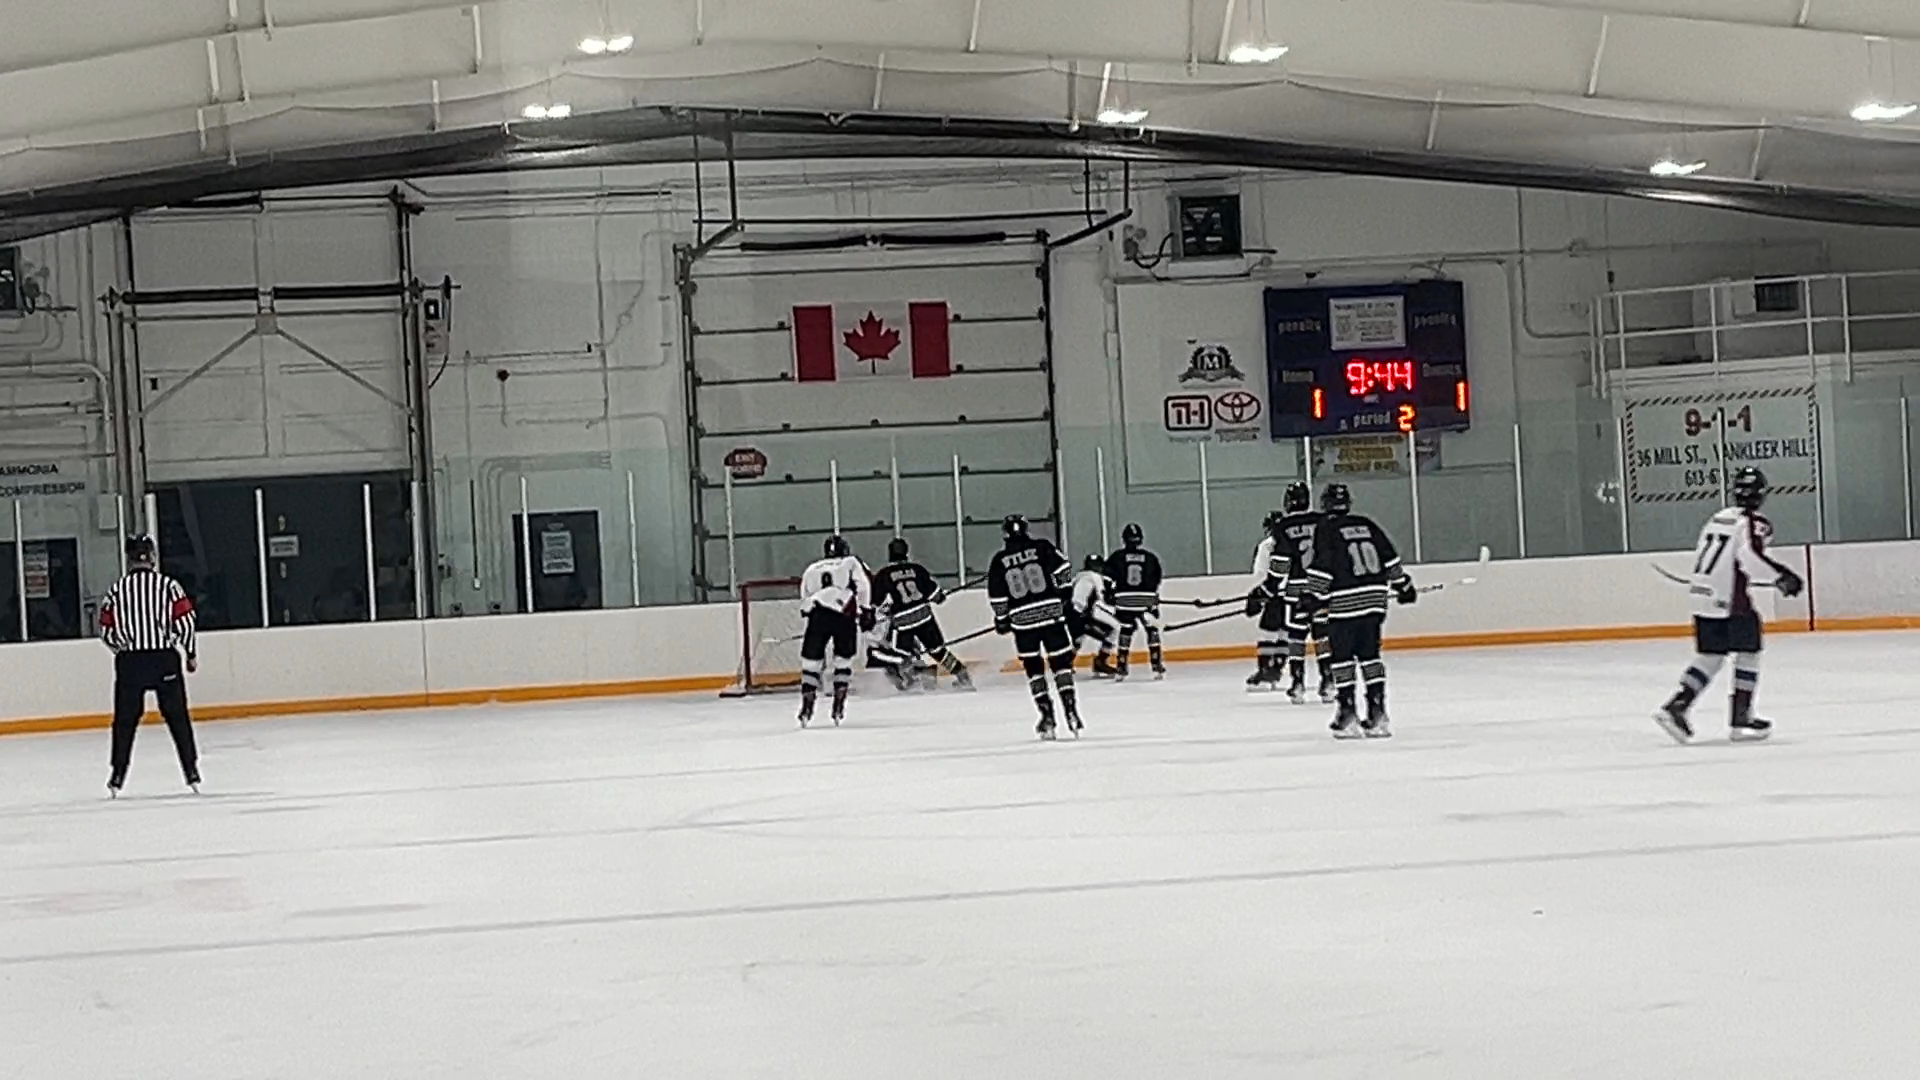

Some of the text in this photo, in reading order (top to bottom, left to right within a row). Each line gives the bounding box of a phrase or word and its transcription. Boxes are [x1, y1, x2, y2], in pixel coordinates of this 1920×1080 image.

[1347, 360, 1412, 394] 9:44
[1313, 387, 1323, 419] 1
[1456, 380, 1467, 412] 1
[1398, 403, 1416, 433] 2
[1654, 446, 1682, 465] MILL
[1781, 438, 1809, 458] HILL
[1347, 541, 1381, 577] 10
[1005, 563, 1047, 599] 88
